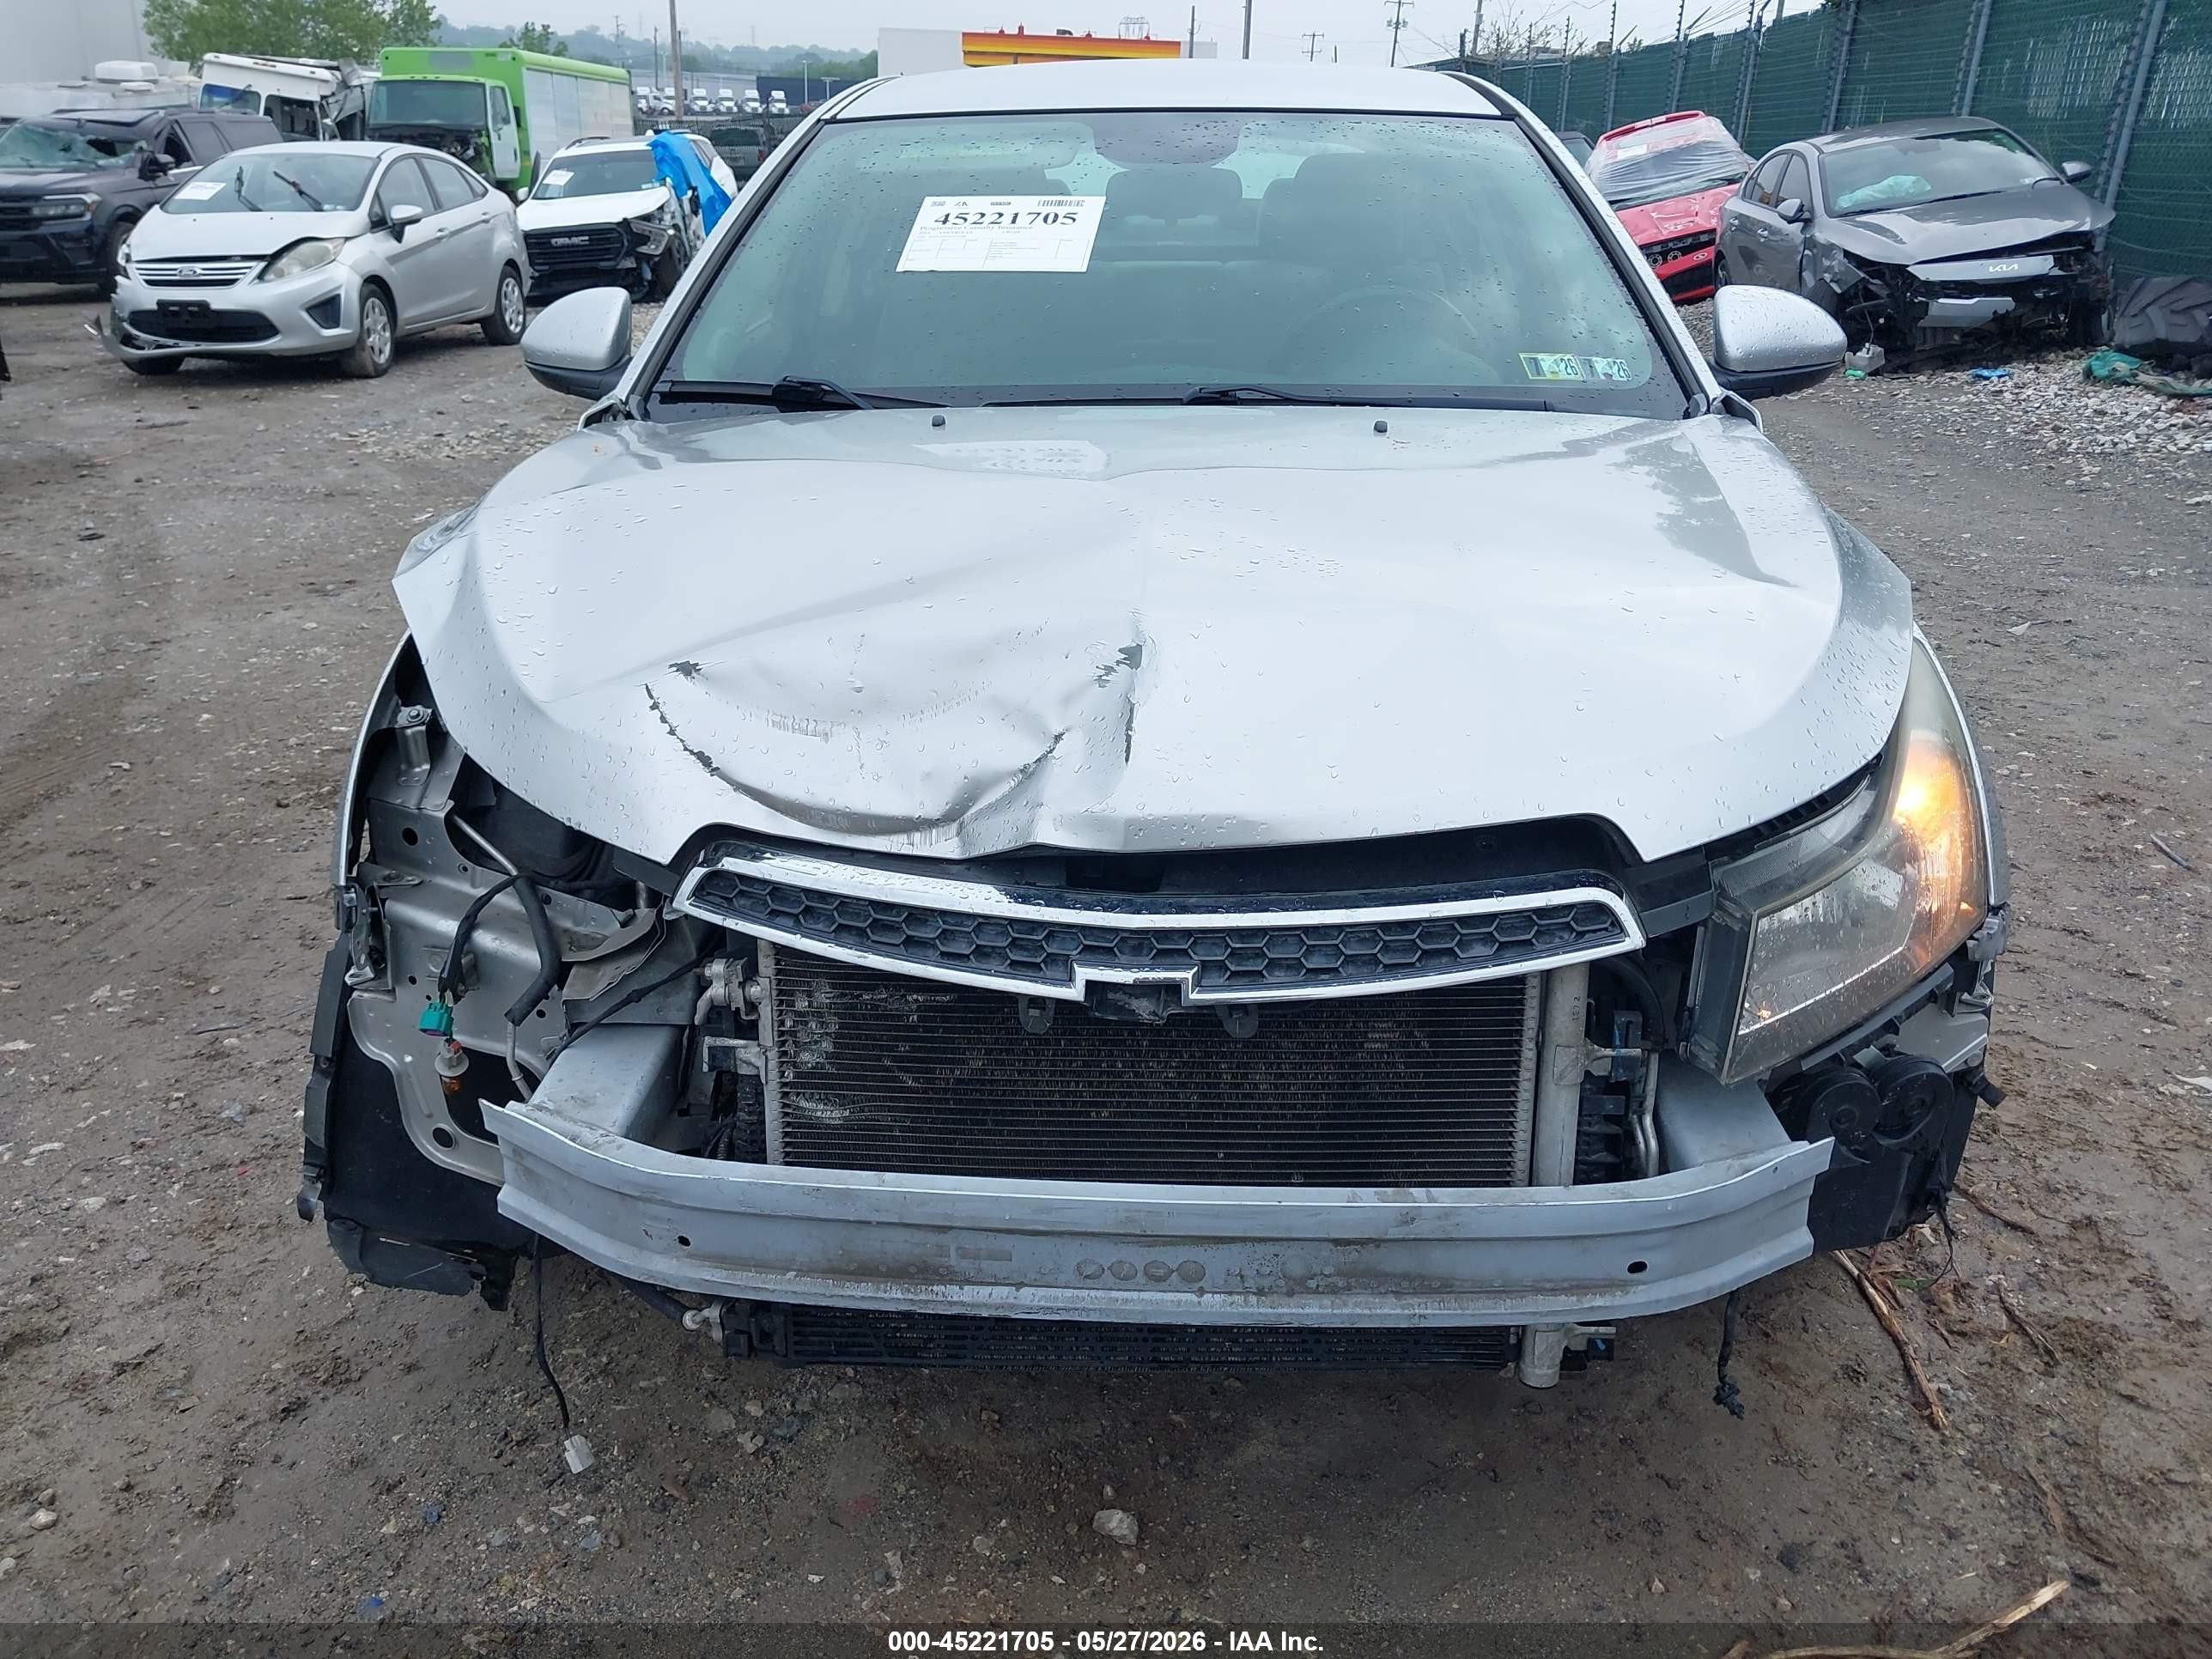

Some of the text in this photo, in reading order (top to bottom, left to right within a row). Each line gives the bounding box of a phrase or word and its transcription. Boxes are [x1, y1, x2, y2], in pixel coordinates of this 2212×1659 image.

[933, 211, 1079, 226] 45221705
[550, 235, 590, 247] GMC
[1560, 357, 1579, 376] 26
[1613, 360, 1632, 379] 26
